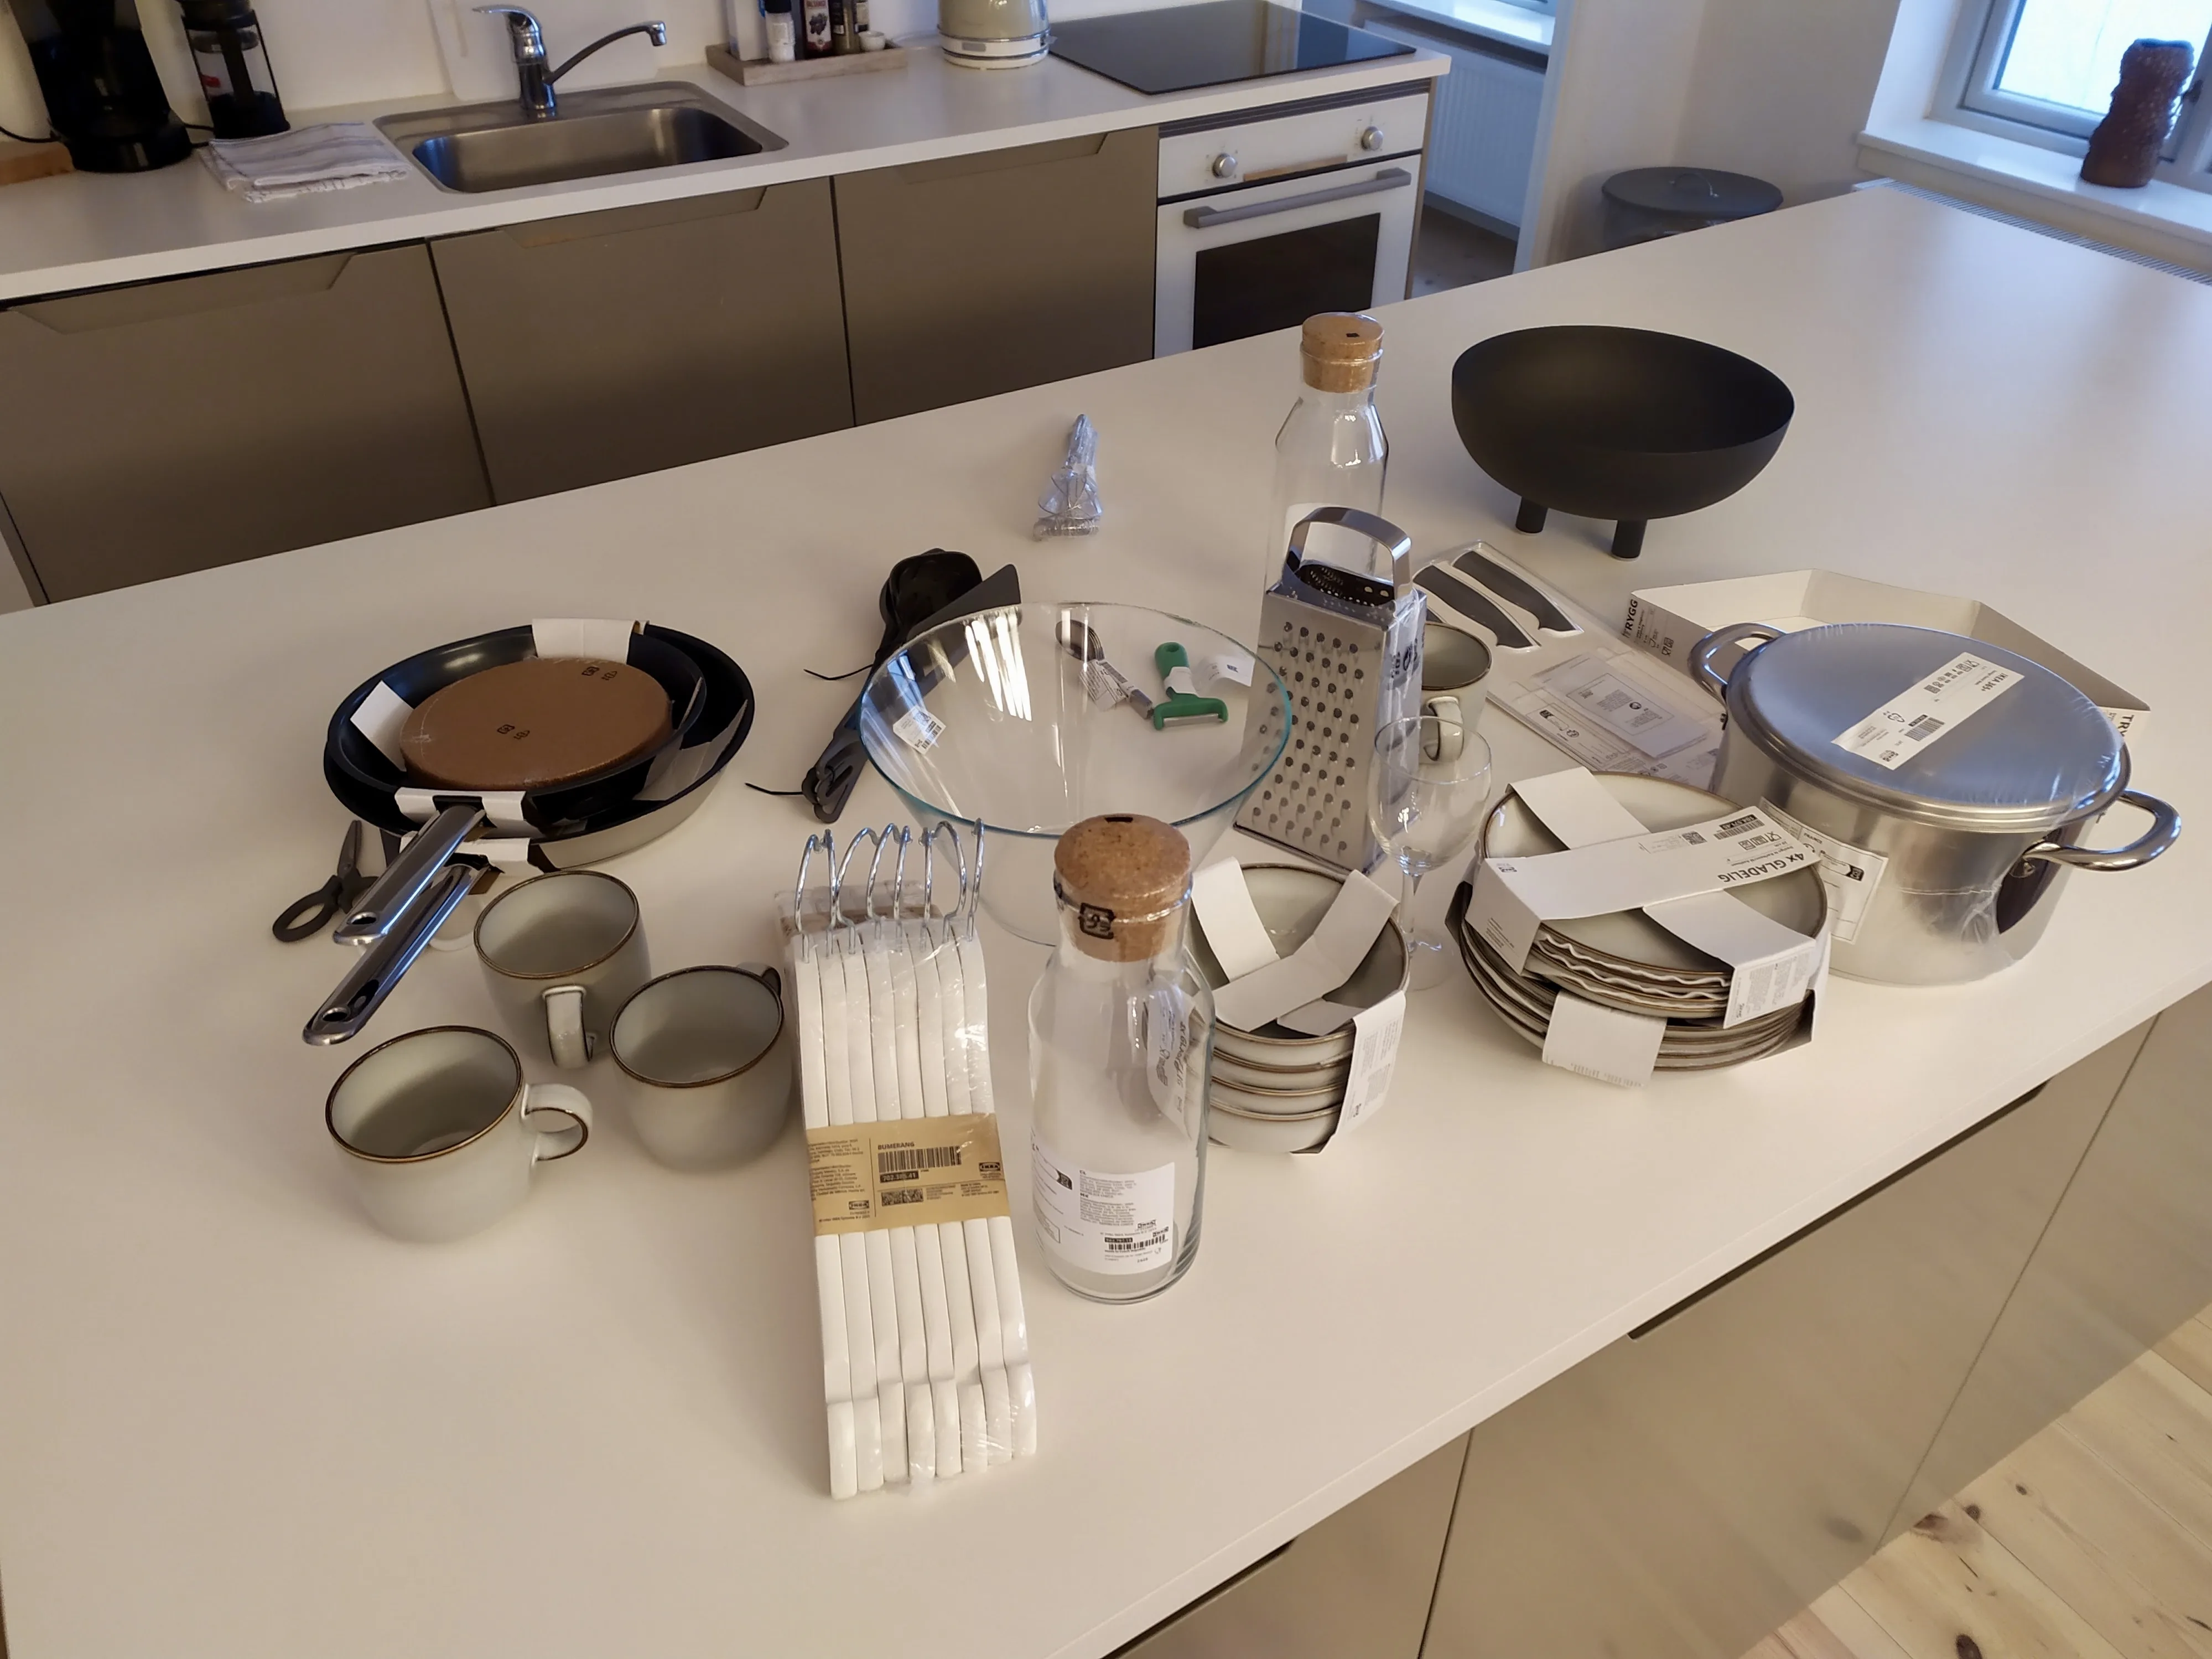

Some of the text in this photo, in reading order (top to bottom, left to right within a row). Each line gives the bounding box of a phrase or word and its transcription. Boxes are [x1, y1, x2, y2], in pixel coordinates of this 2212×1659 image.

[1992, 672, 2008, 682] IKEA
[1785, 853, 1805, 863] 4x
[1717, 859, 1787, 883] GLADELIG
[877, 1142, 915, 1150] BUMERANG
